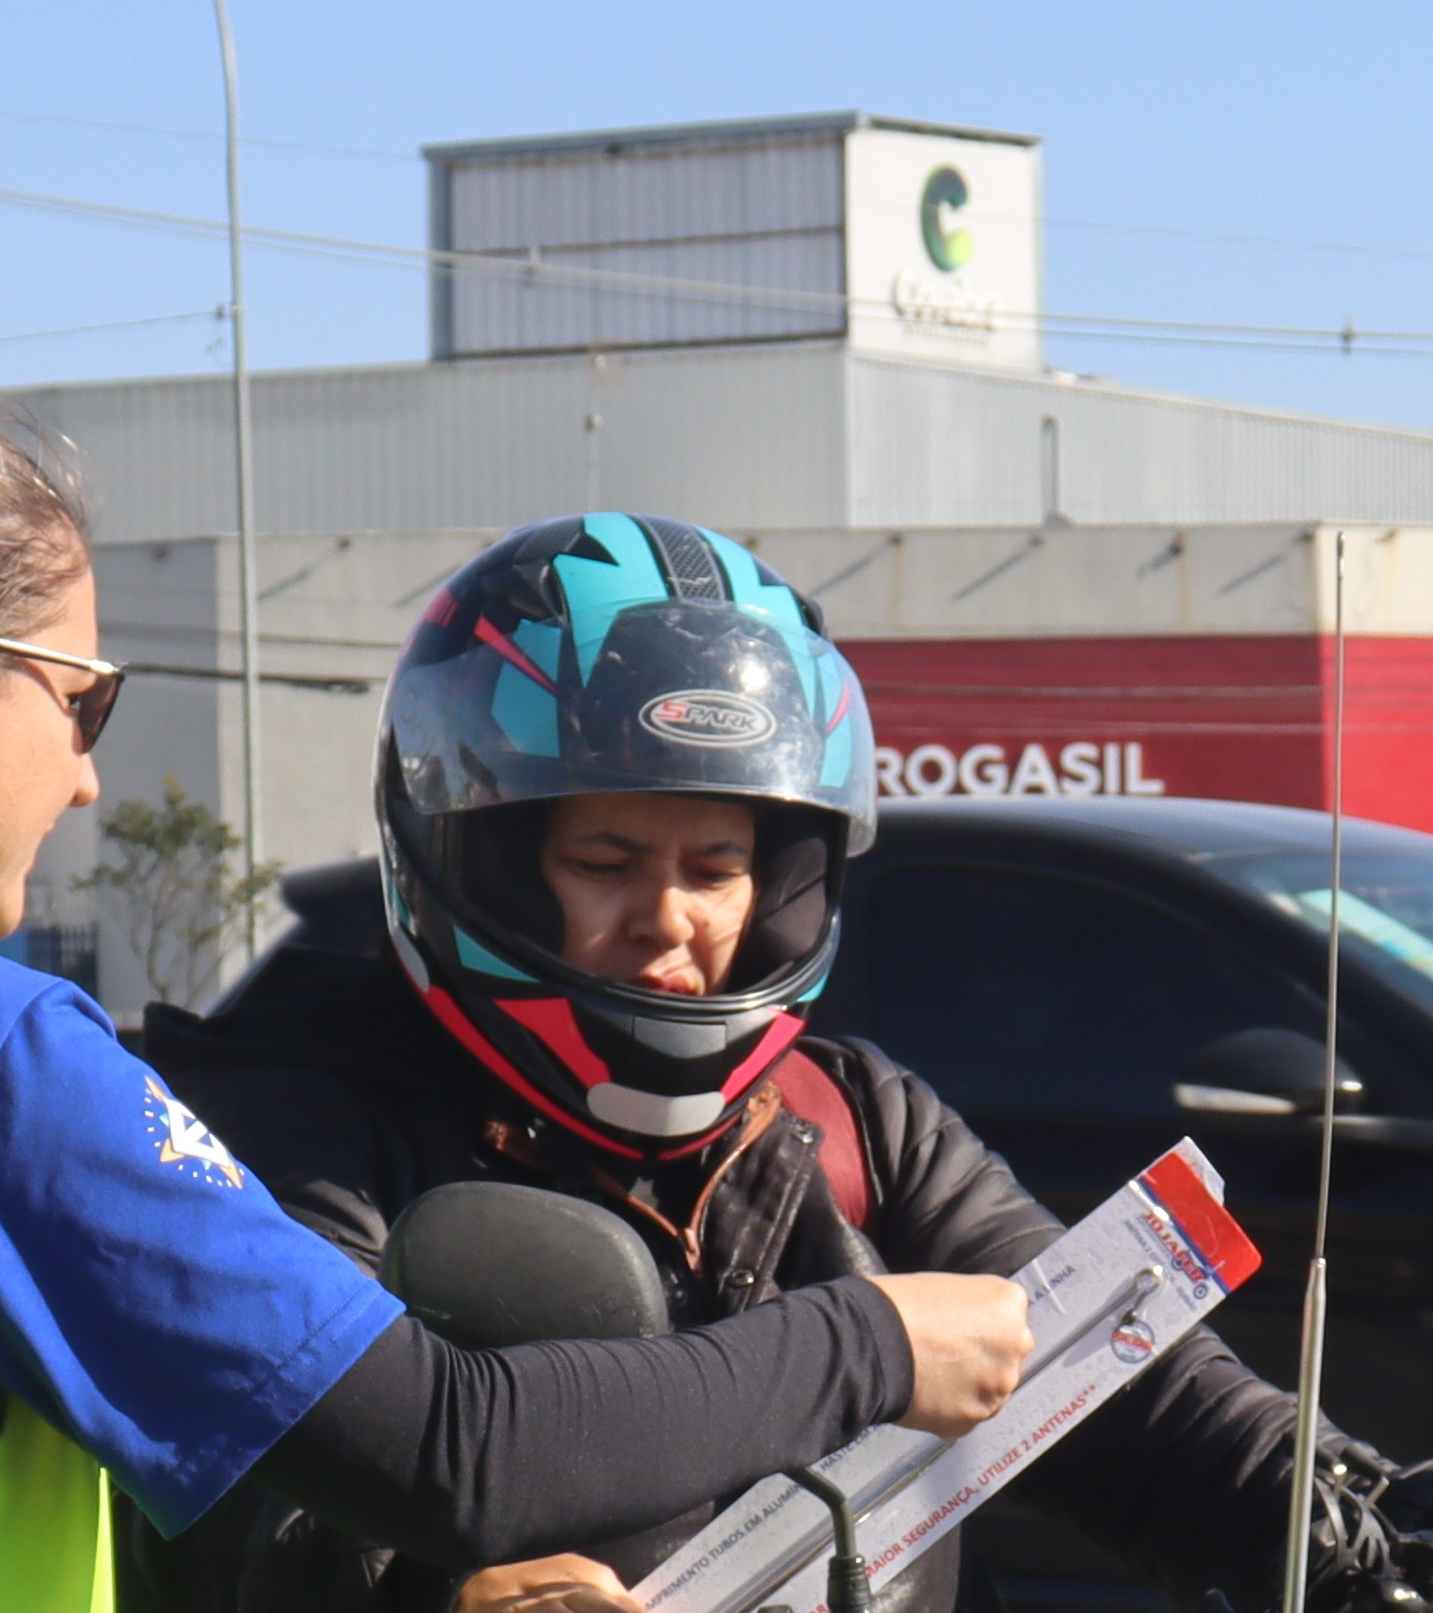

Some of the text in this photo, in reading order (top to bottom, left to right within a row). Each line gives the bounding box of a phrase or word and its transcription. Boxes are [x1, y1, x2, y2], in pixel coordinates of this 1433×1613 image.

[655, 700, 757, 732] SPARK
[875, 741, 1165, 797] ROGASIL
[1041, 1263, 1076, 1293] LNHA
[900, 1479, 982, 1549] SEGURANÇA,
[975, 1445, 1024, 1488] UTILIZE
[1019, 1438, 1033, 1452] 2
[708, 1527, 746, 1560] TUBOS
[742, 1512, 764, 1533] EM
